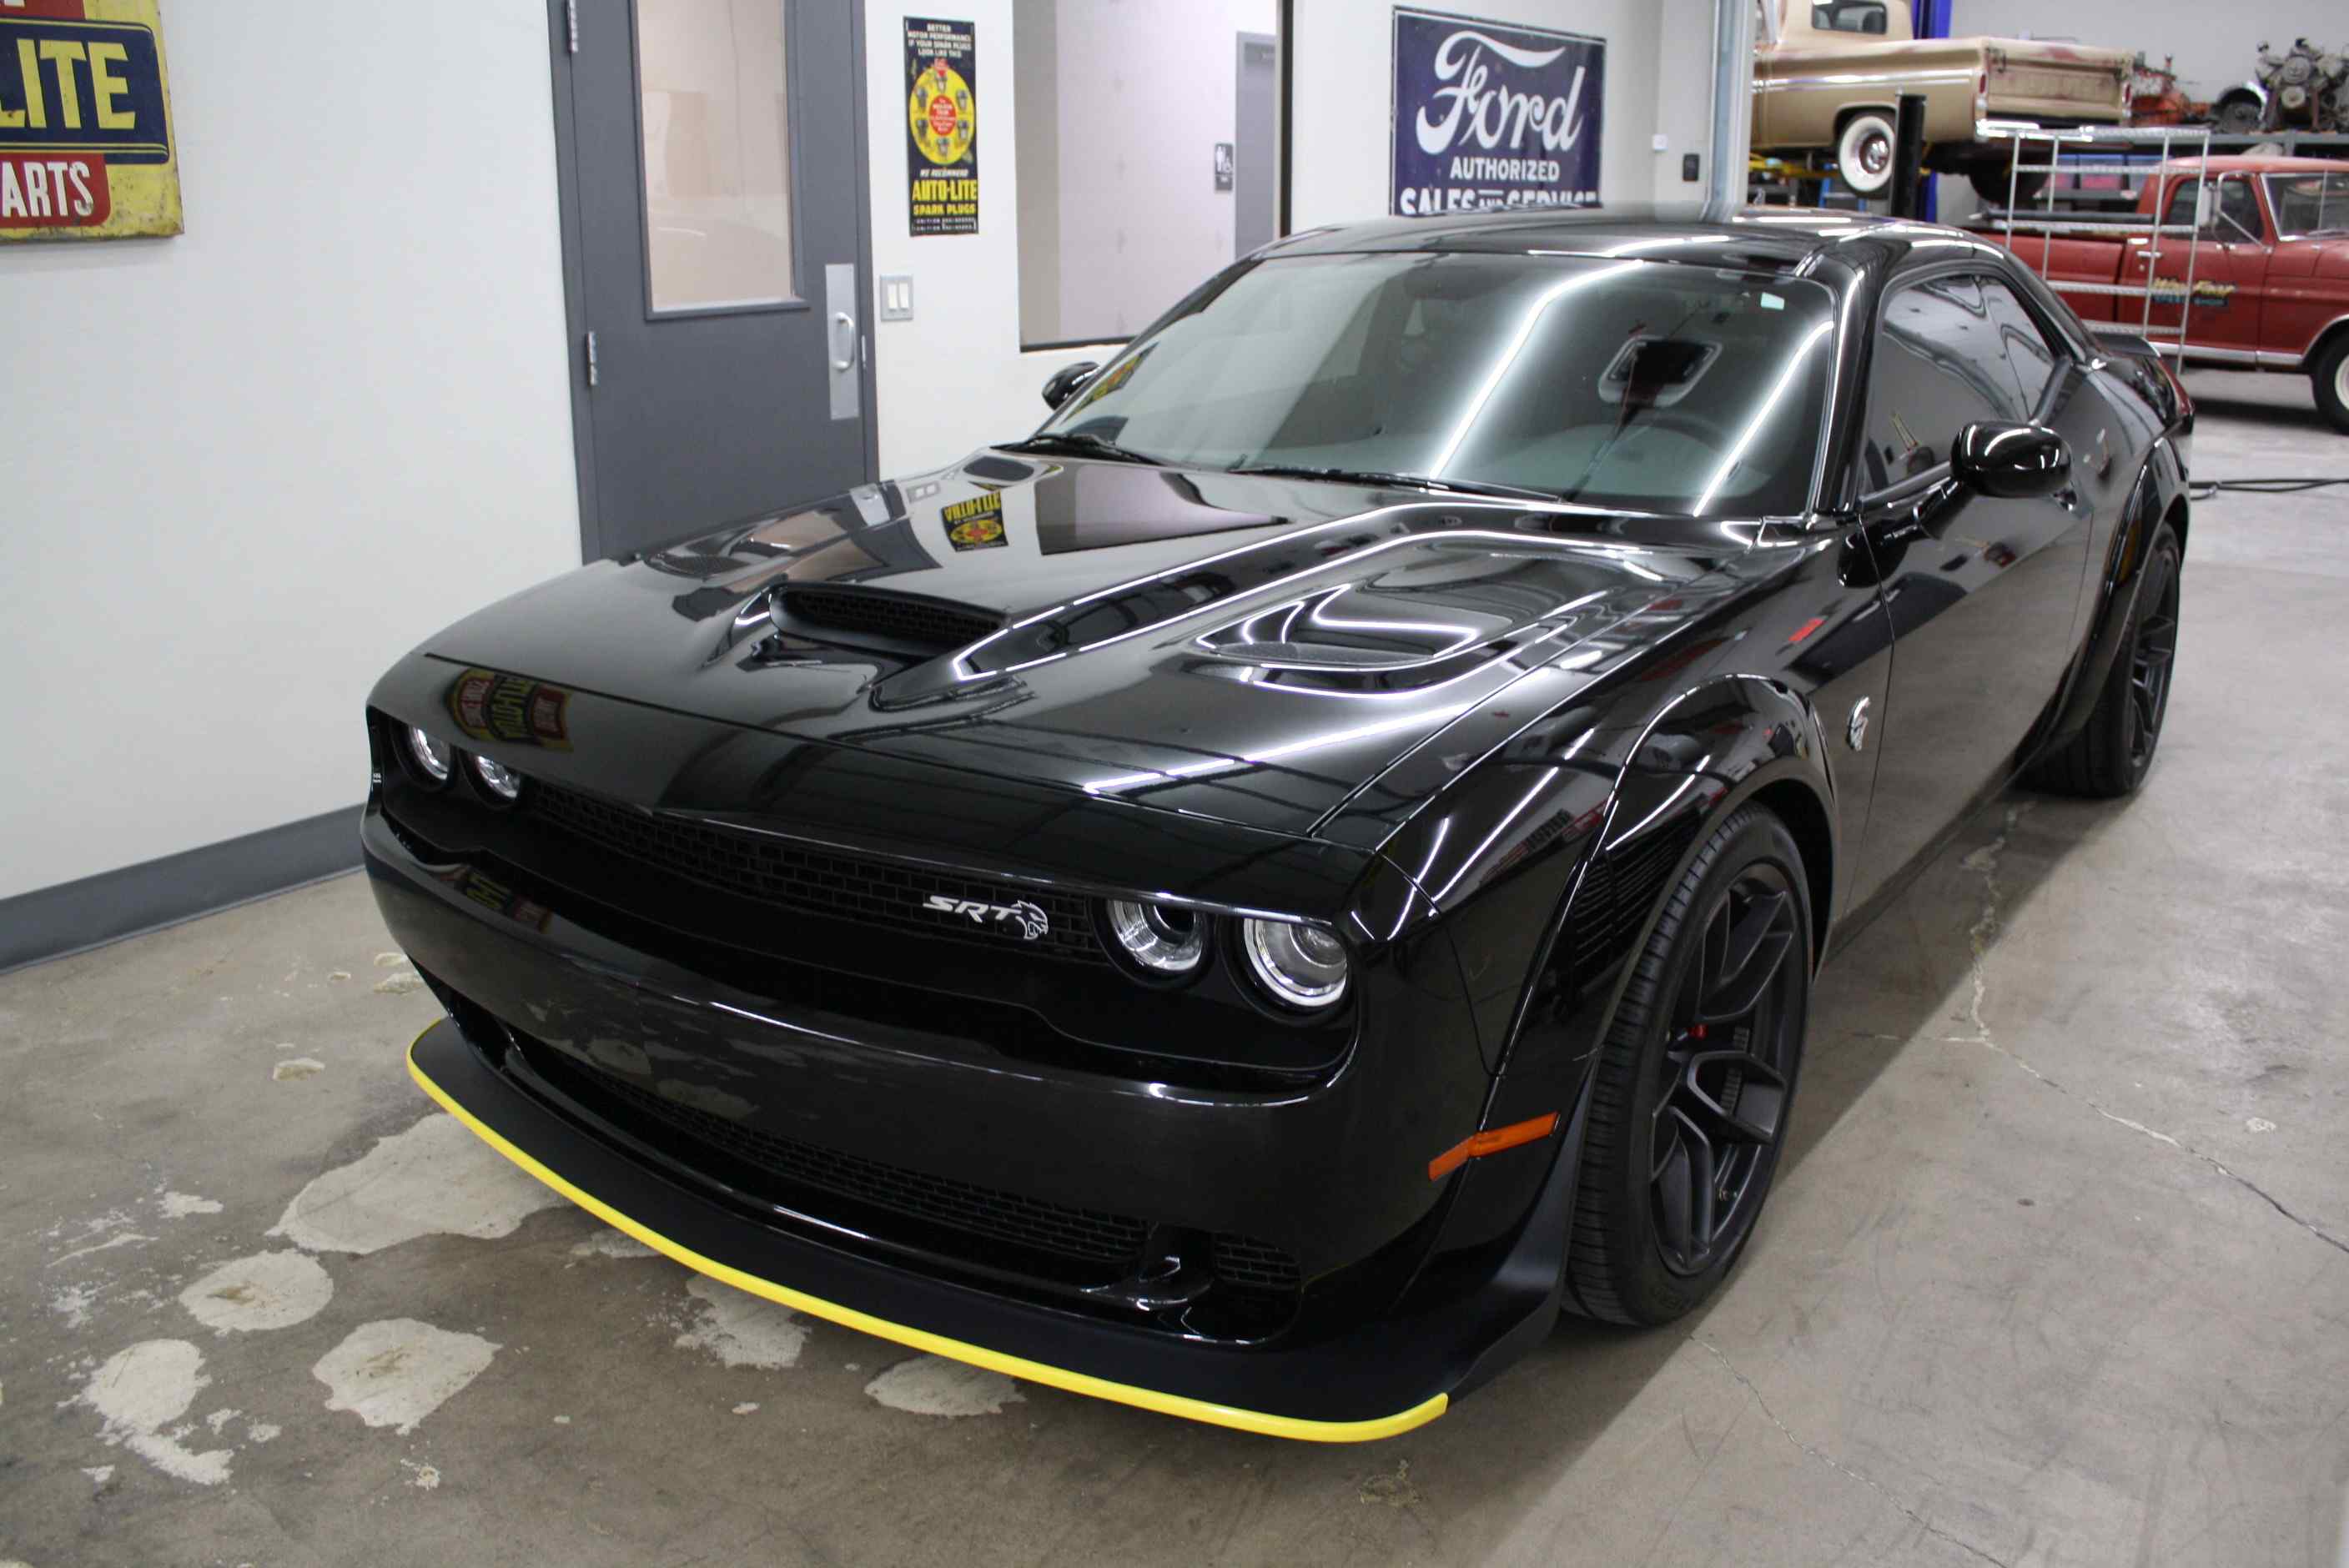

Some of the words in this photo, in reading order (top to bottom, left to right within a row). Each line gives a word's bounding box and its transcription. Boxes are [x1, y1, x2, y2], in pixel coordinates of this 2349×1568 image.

[927, 23, 951, 32] BETTER
[1416, 30, 1586, 154] Ford
[1450, 156, 1559, 182] AUTHORIZED
[912, 179, 978, 201] AUTO-LITE
[1400, 187, 1476, 214] SALES
[913, 204, 944, 215] SPARK
[947, 203, 975, 214] PLUGS
[923, 895, 1022, 923] SRT
